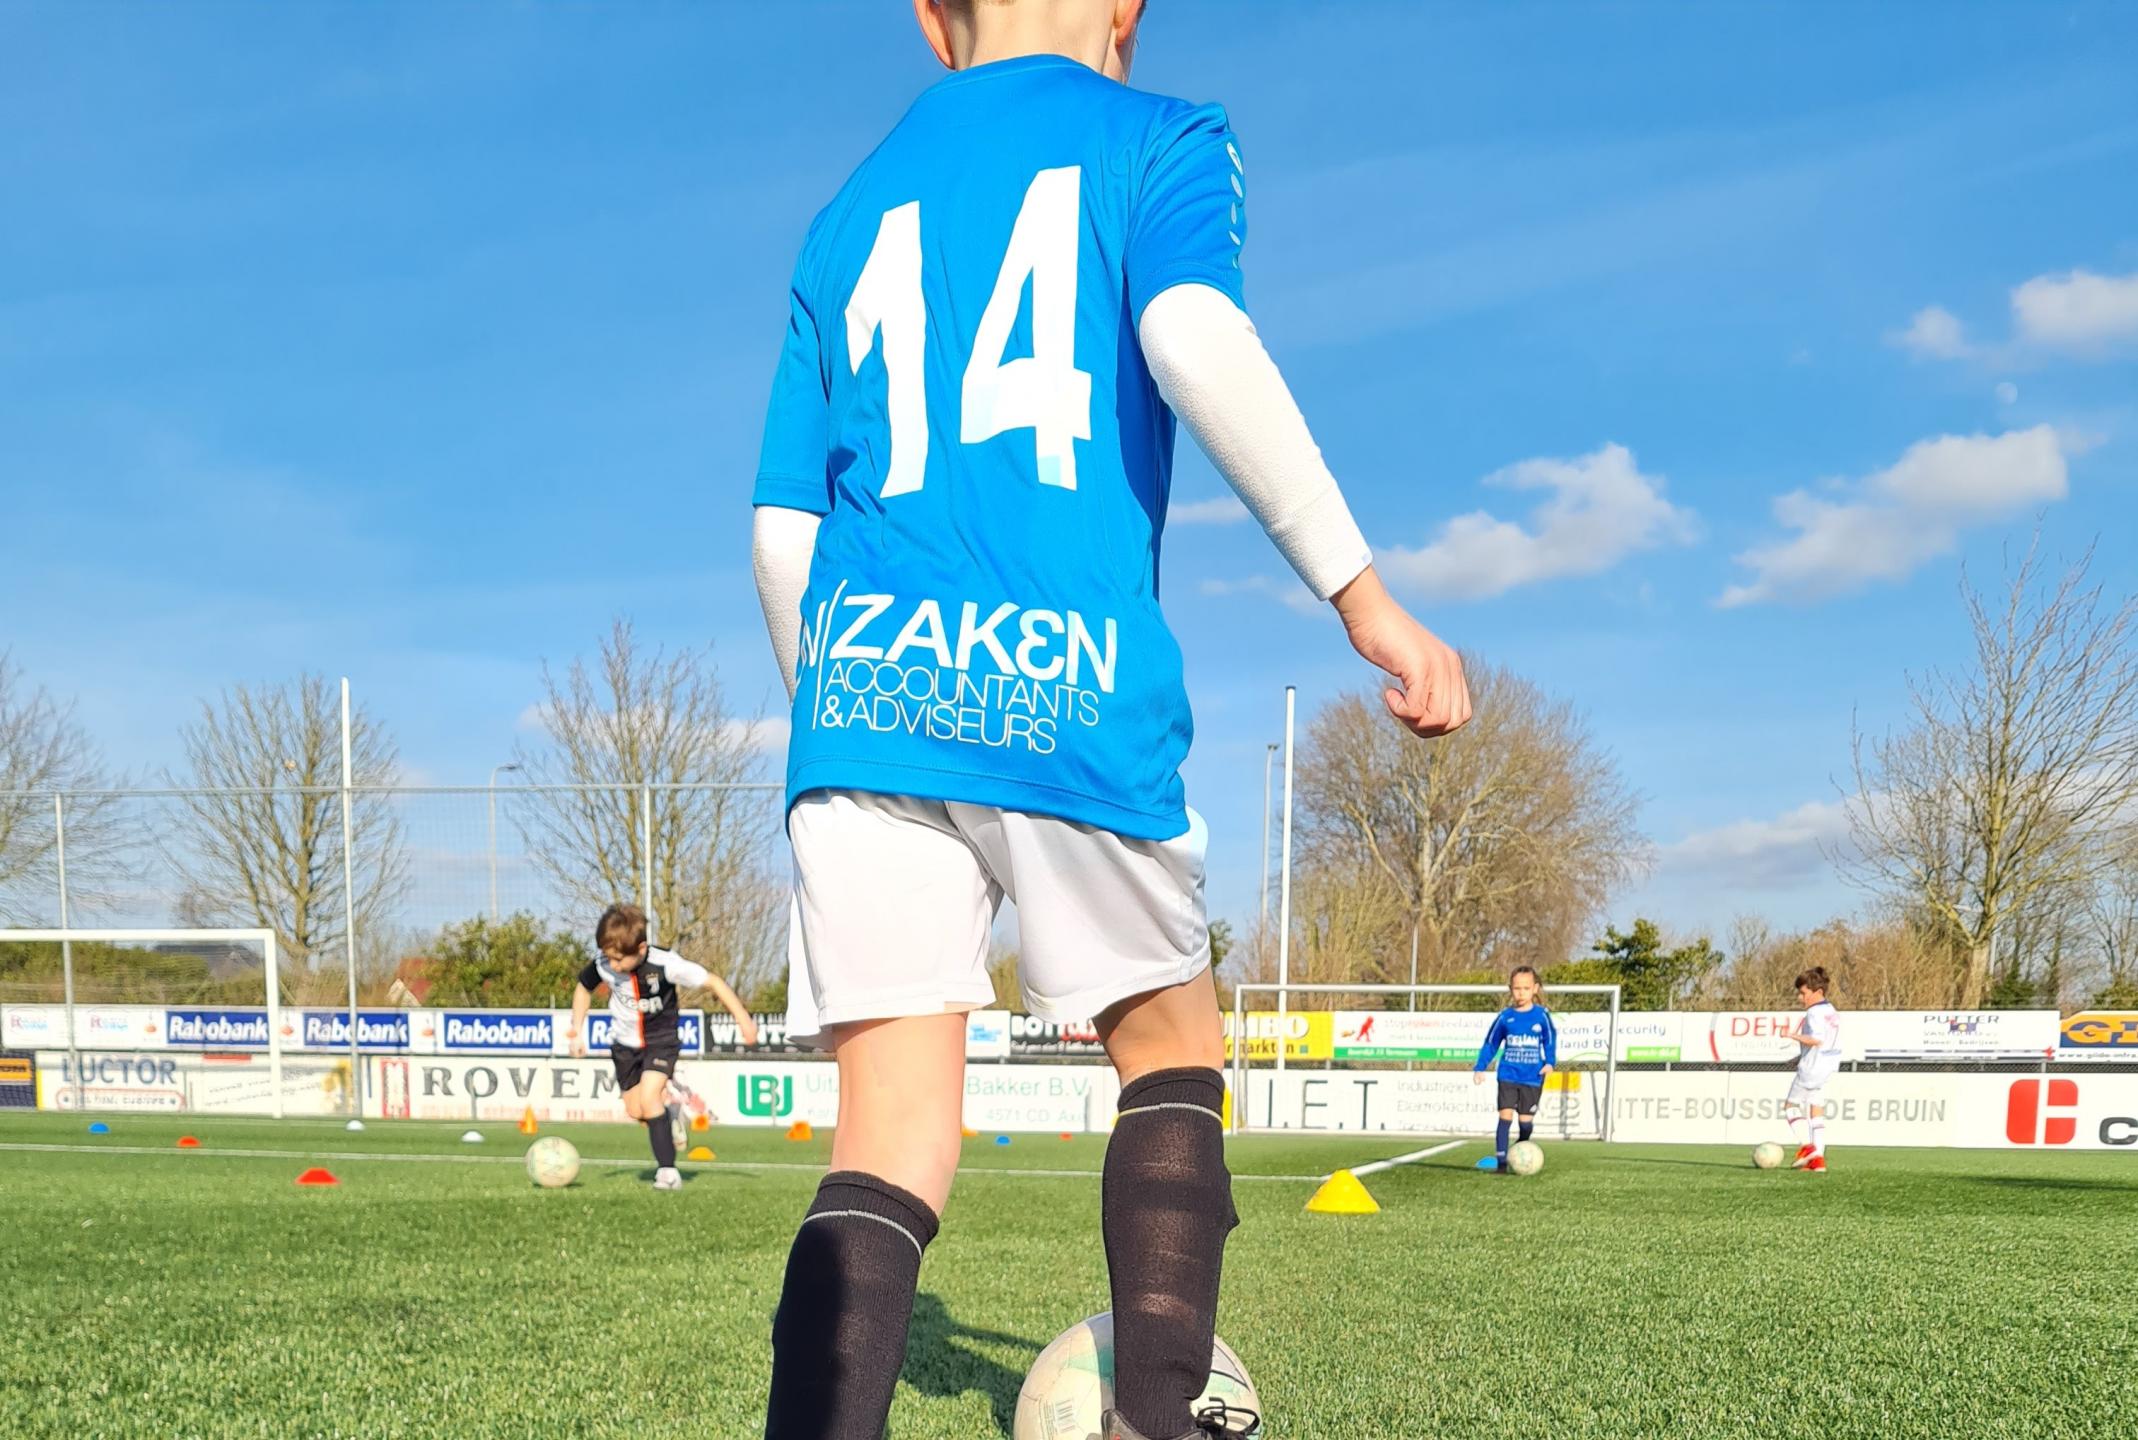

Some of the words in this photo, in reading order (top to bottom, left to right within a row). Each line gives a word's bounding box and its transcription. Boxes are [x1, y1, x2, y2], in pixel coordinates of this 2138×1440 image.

[844, 164, 1092, 498] 14
[824, 658, 1099, 727] ACCOUNTANTS
[169, 1015, 268, 1041] Rabobank
[306, 1016, 408, 1043] Rabobank
[447, 1017, 551, 1044] Rabobank
[1617, 1023, 1667, 1037] ecurity
[1923, 1015, 2000, 1024] PUTTER
[61, 1057, 177, 1085] LUCTOR
[966, 1075, 1041, 1096] Bakker
[1867, 1099, 1946, 1122] BRUIN
